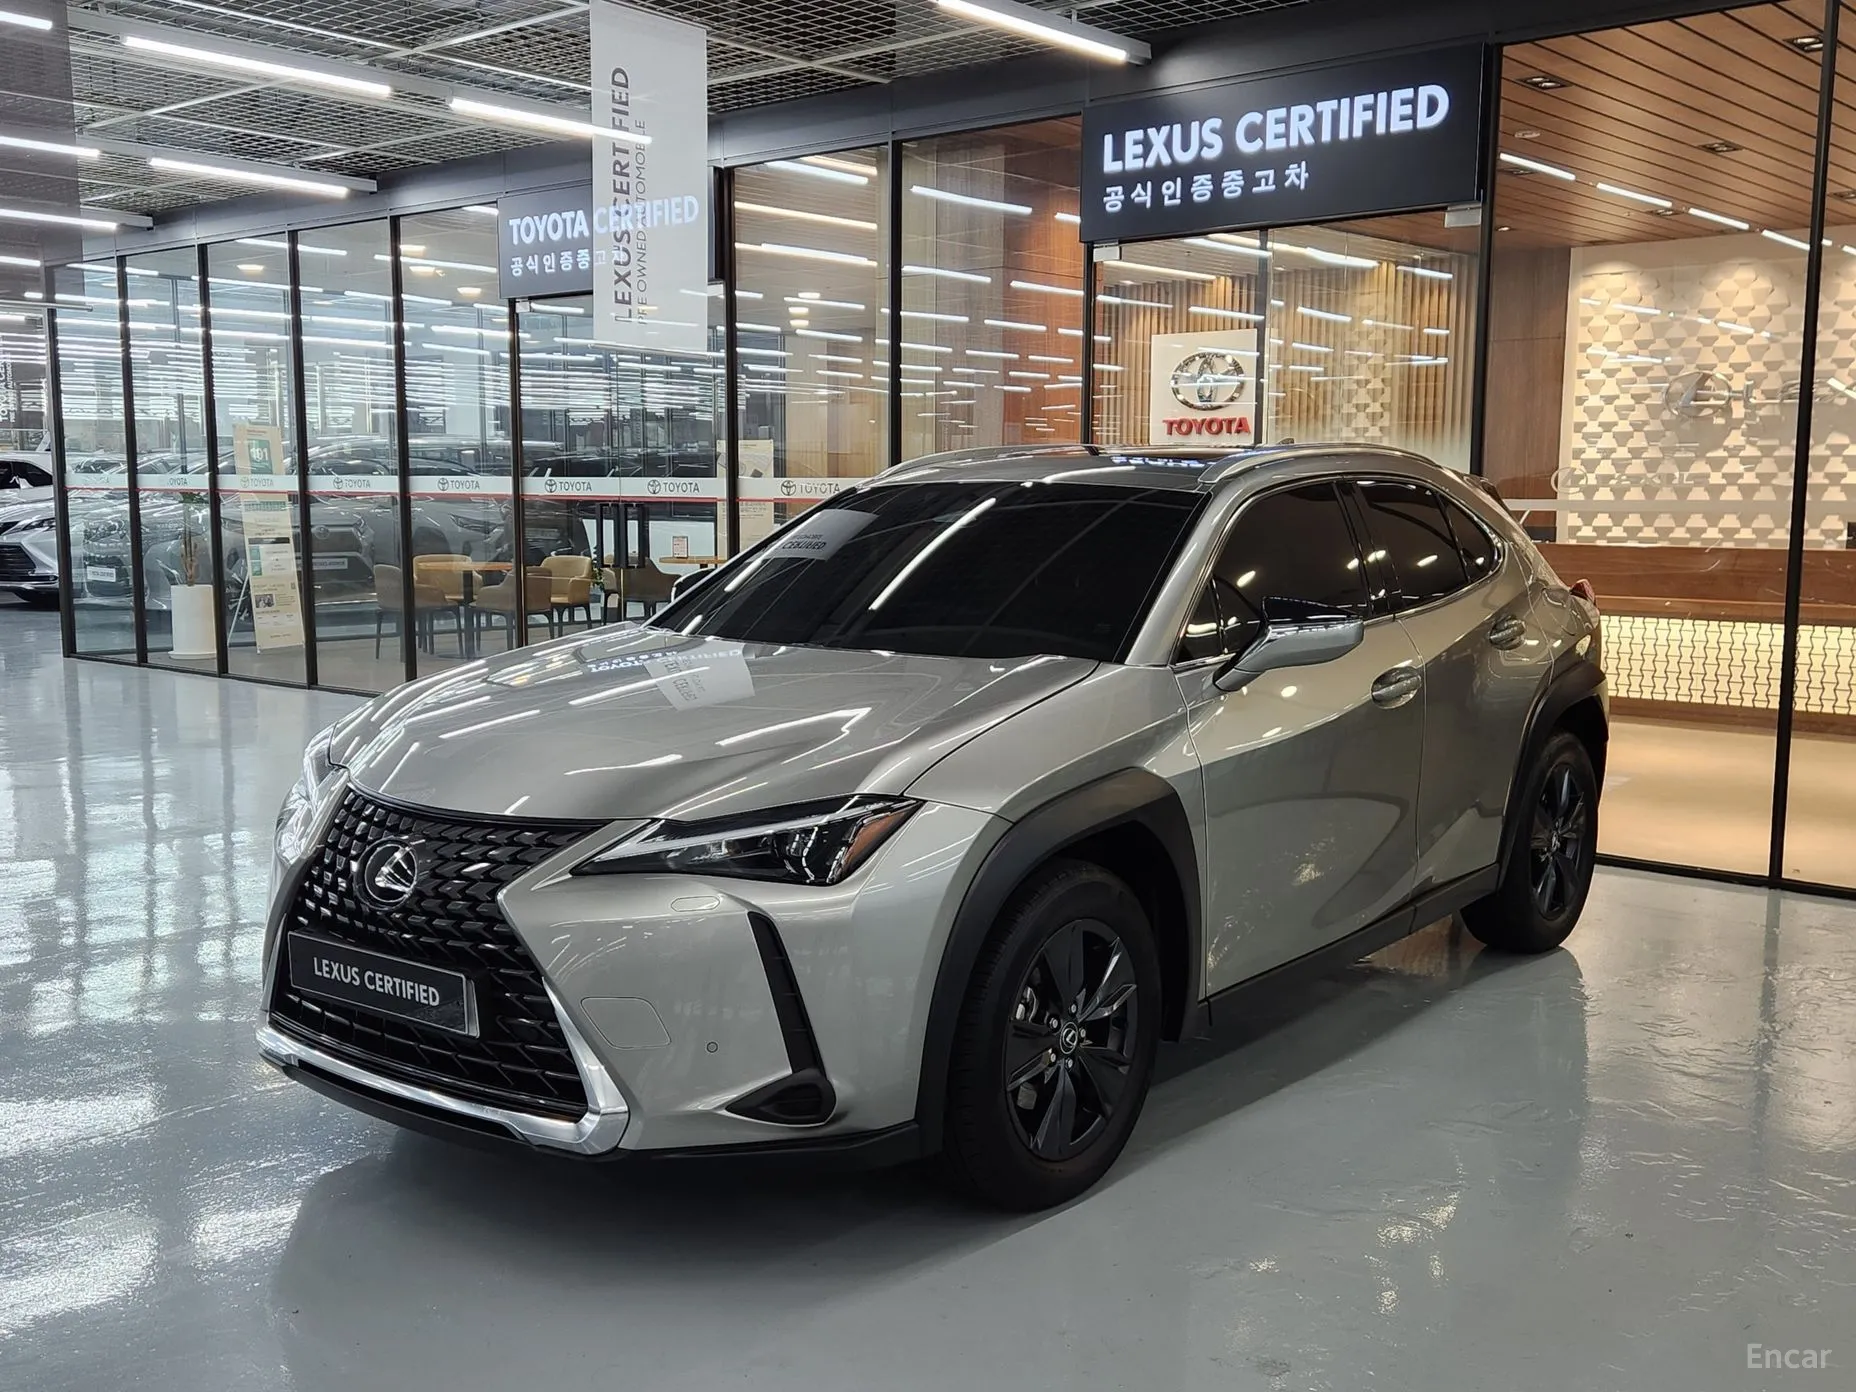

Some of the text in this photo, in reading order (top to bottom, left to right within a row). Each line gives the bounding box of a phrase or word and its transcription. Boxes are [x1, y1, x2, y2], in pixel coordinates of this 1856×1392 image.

[1103, 83, 1450, 174] LEXUS CERTIFIED
[635, 119, 648, 227] AUTOMOBE
[611, 67, 632, 322] LEXUS CERTFIED
[1103, 160, 1309, 213] 공식인증중고차
[508, 195, 699, 246] TOYOTA CERTIFIED
[636, 230, 648, 293] OWNED
[1162, 416, 1252, 436] TOYOTA
[167, 478, 188, 486] OYOTA
[250, 478, 274, 487] TOYOTA
[344, 478, 371, 488] TOYOTA
[450, 480, 481, 490] TOYOTA
[558, 481, 593, 491] TOYOTA
[662, 482, 700, 493] TOYOTA
[799, 482, 840, 494] TOYOTA
[313, 956, 440, 1007] LEXUS CERTIFIED
